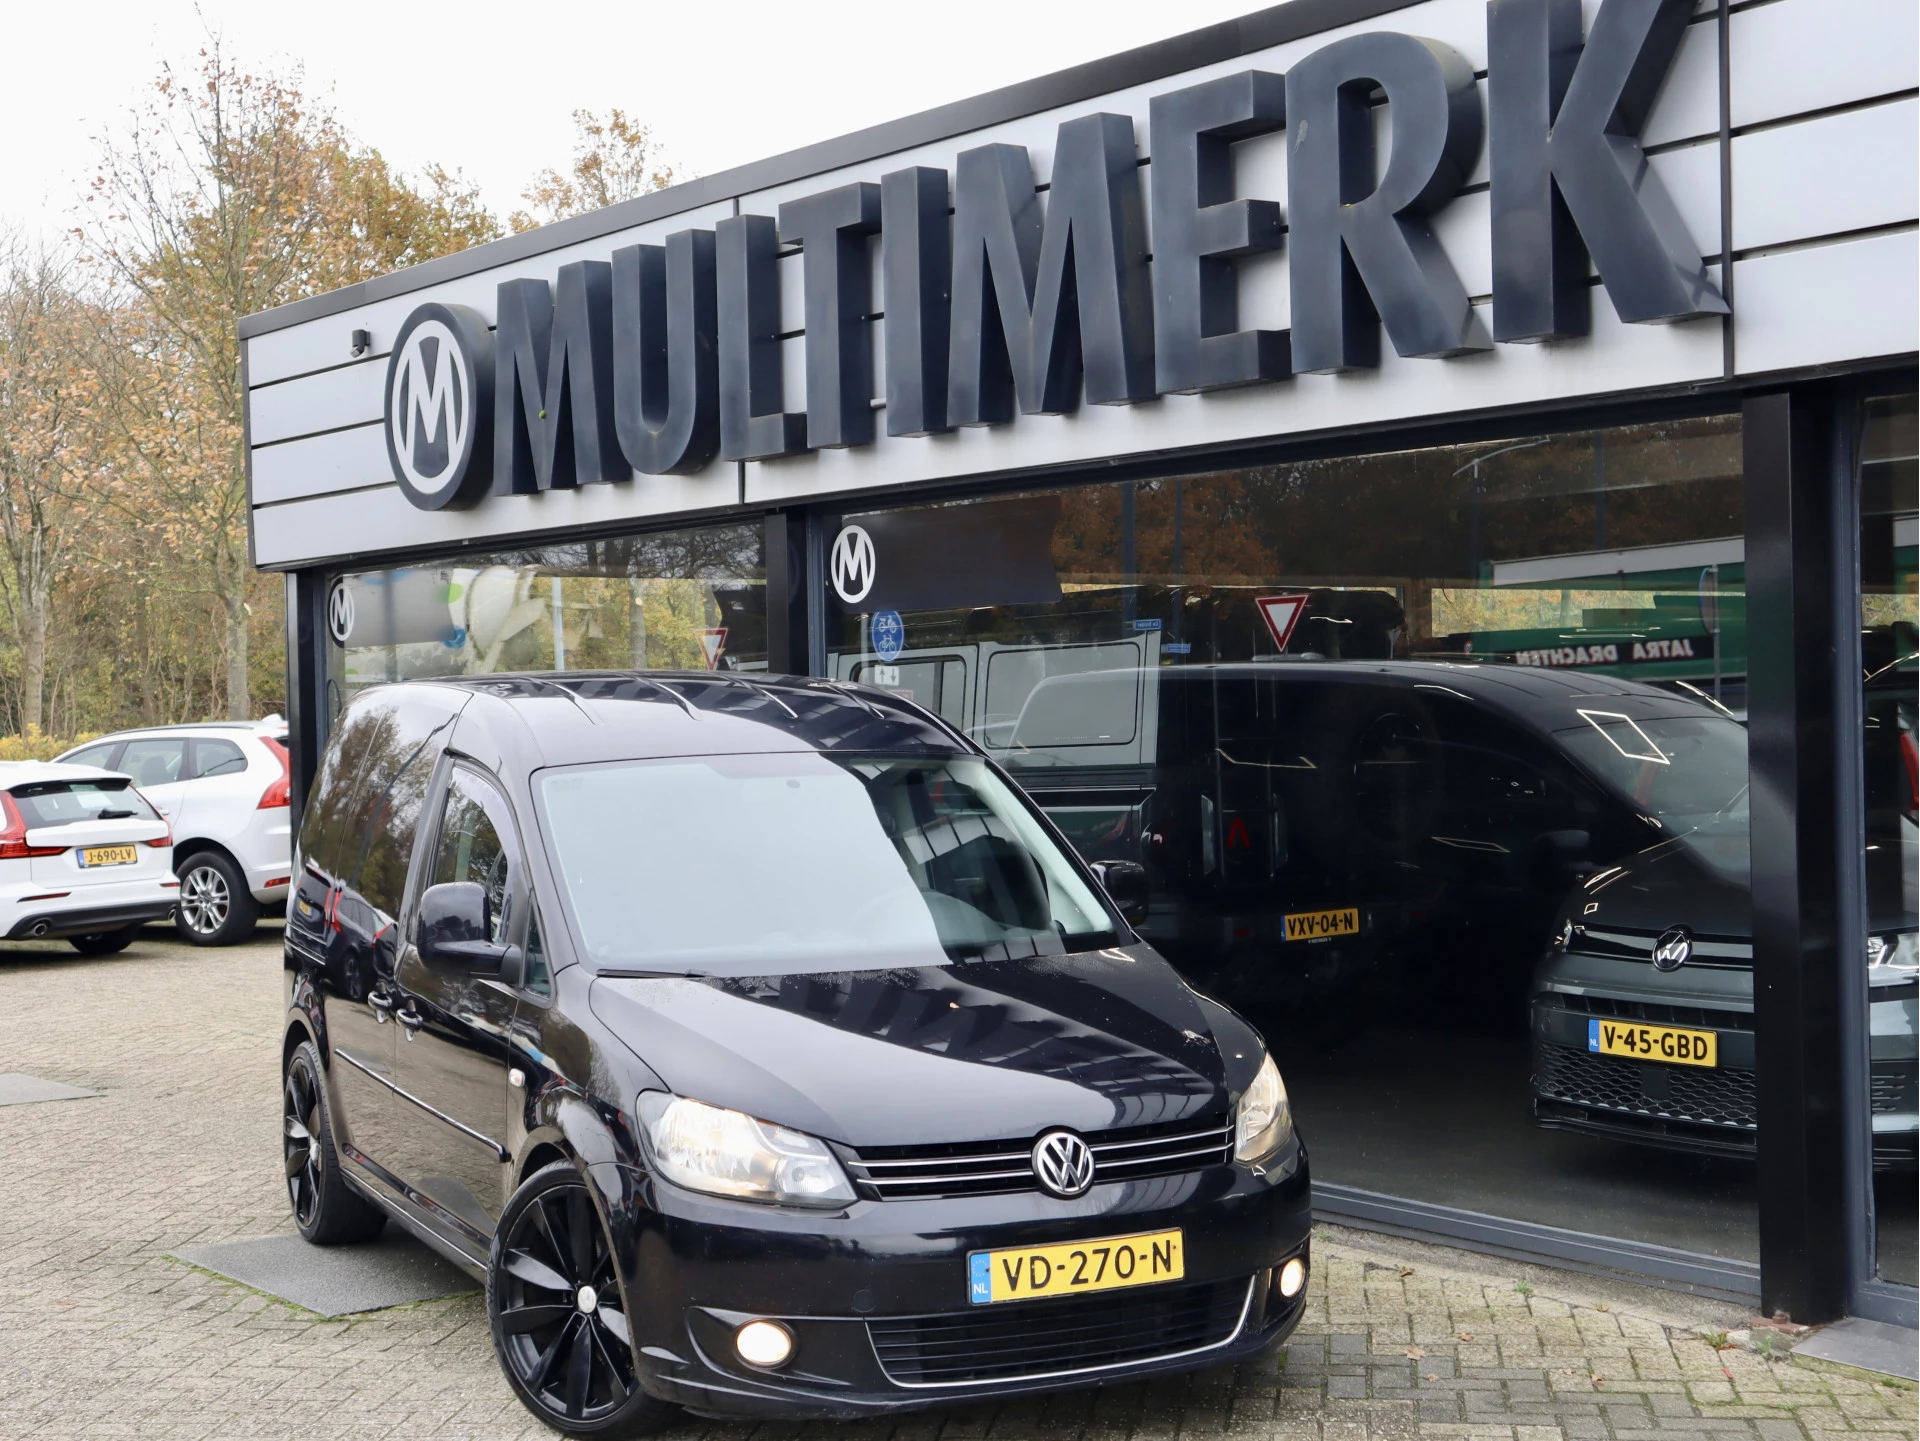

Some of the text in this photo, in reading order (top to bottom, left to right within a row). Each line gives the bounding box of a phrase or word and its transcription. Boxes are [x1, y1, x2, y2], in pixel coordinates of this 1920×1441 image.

[494, 0, 1729, 497] MULTIMERK
[88, 849, 131, 863] J-690-LV
[1287, 912, 1354, 936] VXV-04-N
[1603, 1025, 1708, 1060] V-45-GBD
[1002, 1239, 1172, 1291] VD-270-N
[973, 1282, 988, 1295] NL
